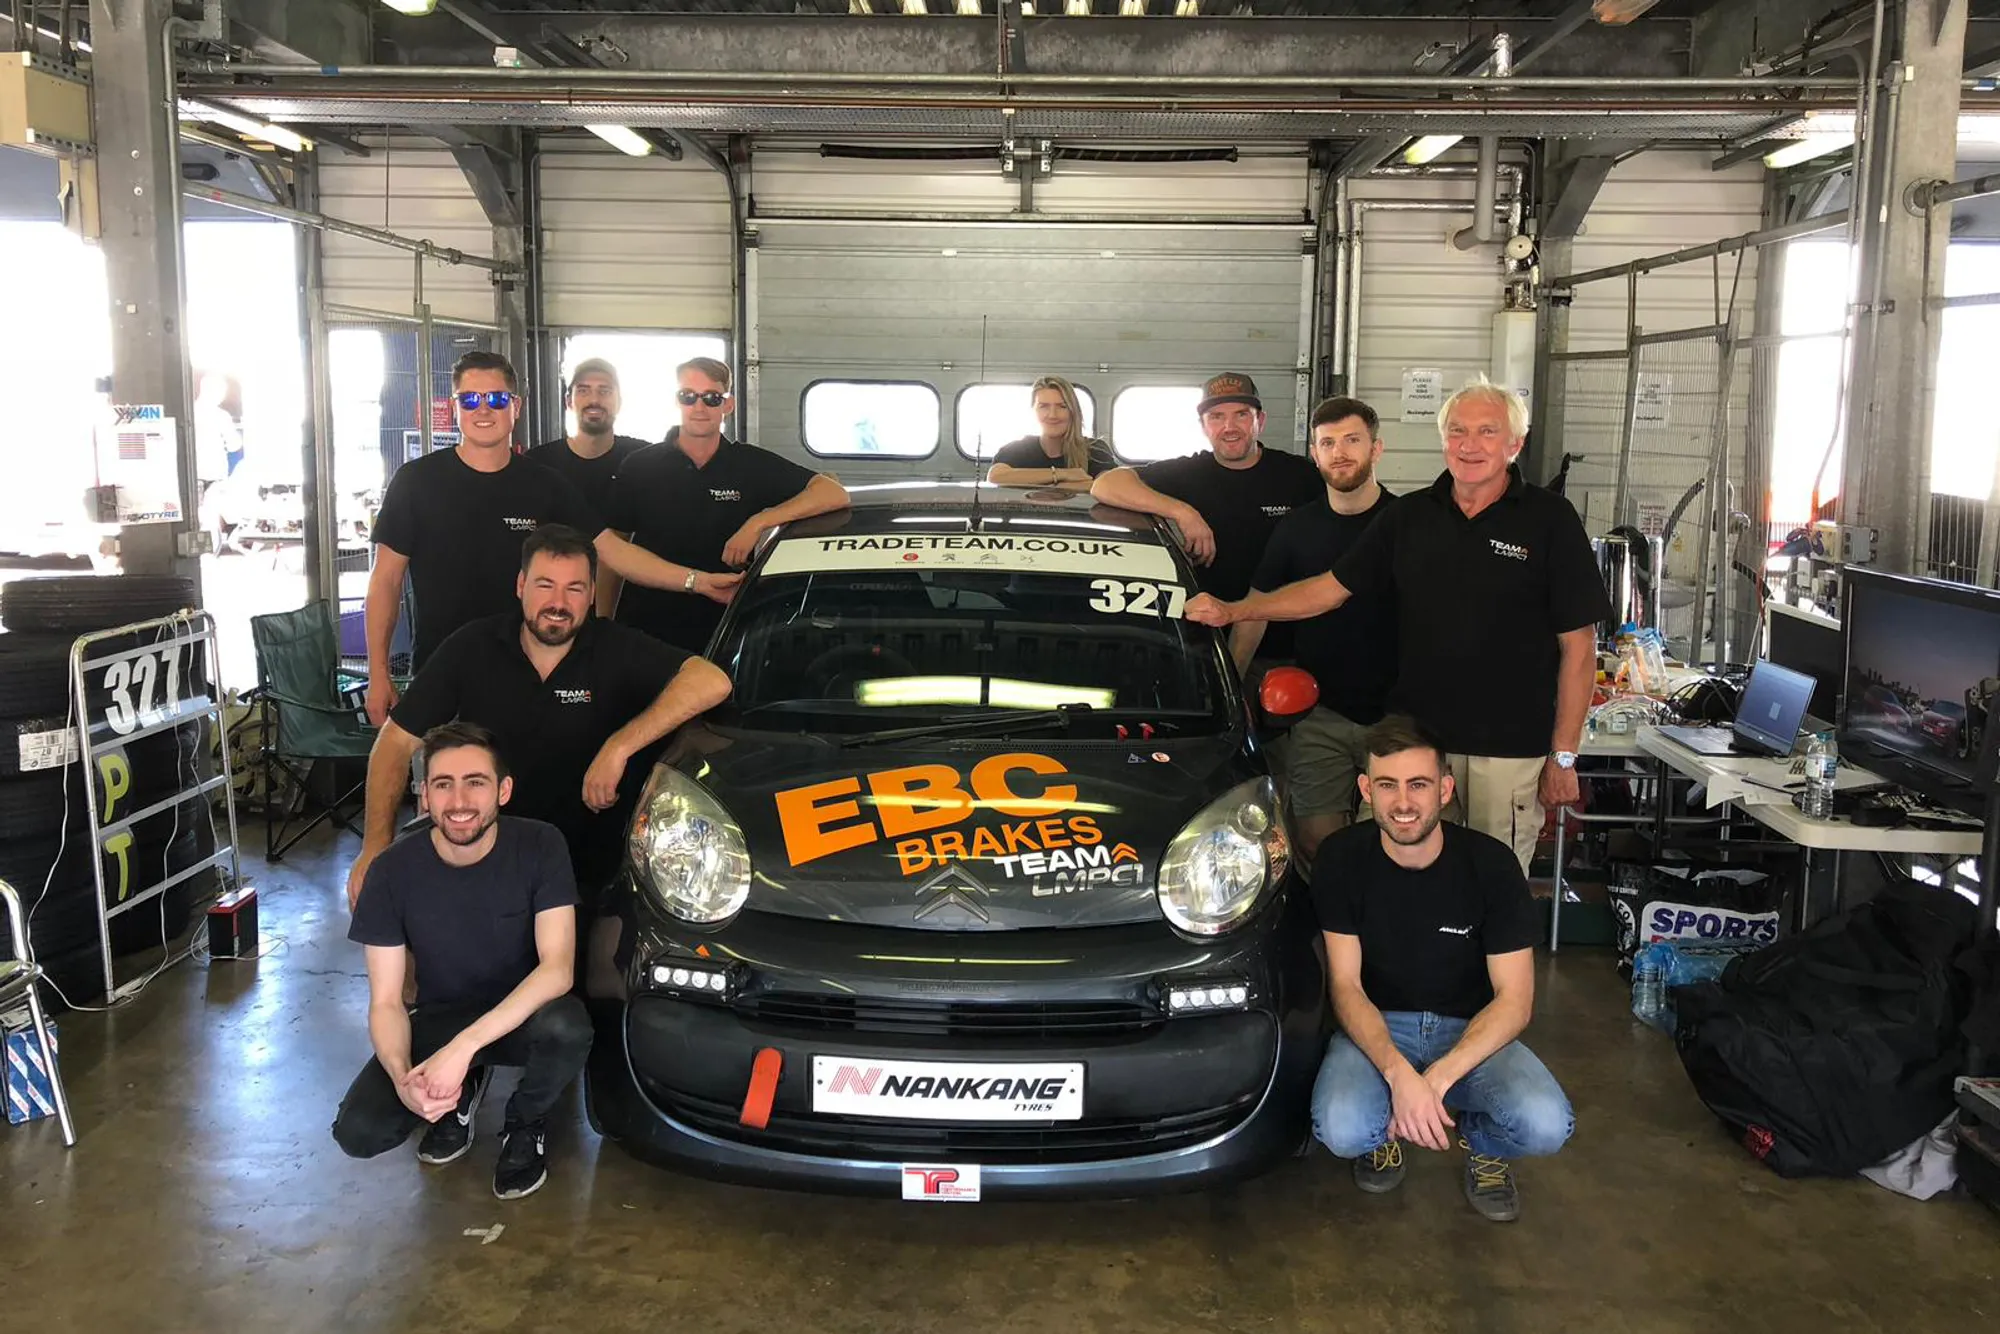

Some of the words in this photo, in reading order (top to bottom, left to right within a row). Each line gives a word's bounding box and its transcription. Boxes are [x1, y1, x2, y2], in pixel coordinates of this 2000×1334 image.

[817, 537, 1124, 558] TRADETEAM.CO.UK
[1489, 539, 1521, 553] TEAM
[1089, 579, 1187, 620] 327
[103, 644, 182, 735] 327
[98, 754, 130, 824] P
[775, 752, 1078, 867] EBC
[895, 816, 1103, 876] BRAKES
[993, 845, 1112, 878] TEAM
[104, 831, 133, 901] T
[1650, 908, 1778, 943] SPORTS
[880, 1075, 1067, 1100] NANKANG
[1013, 1103, 1053, 1112] TYRES
